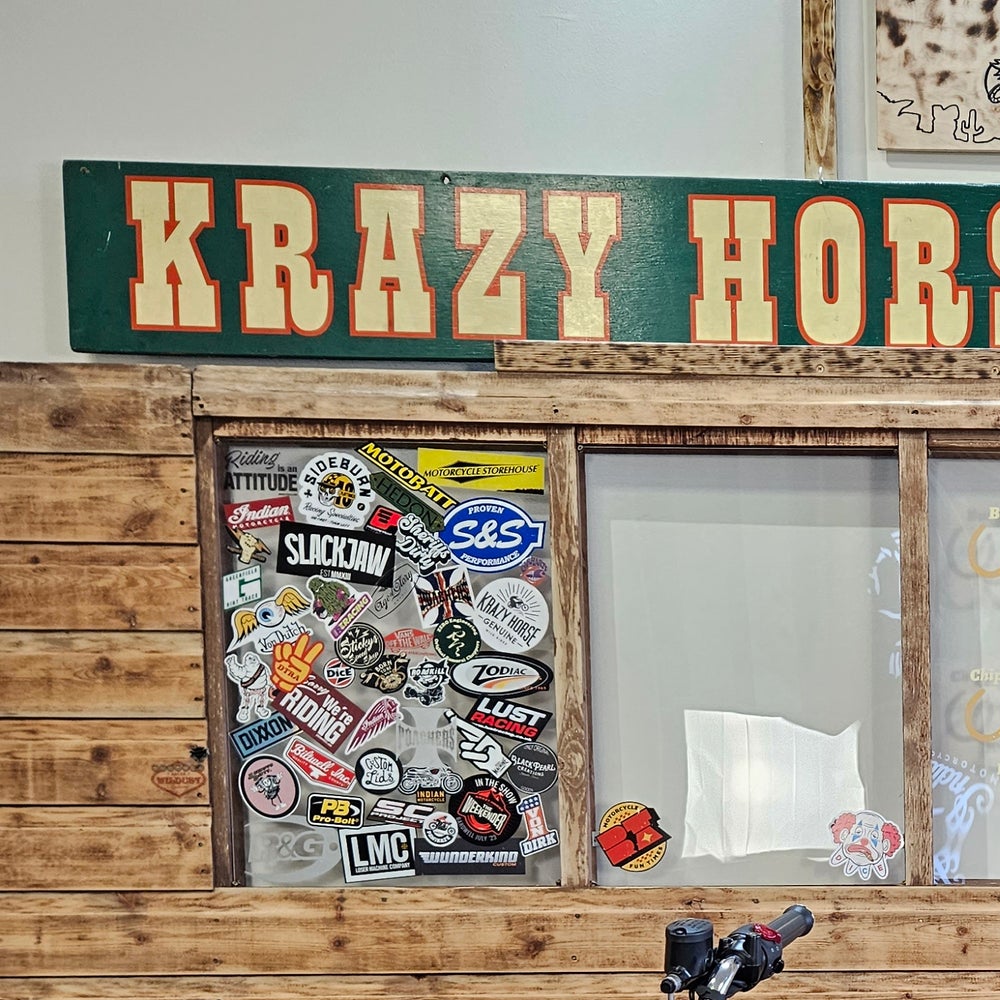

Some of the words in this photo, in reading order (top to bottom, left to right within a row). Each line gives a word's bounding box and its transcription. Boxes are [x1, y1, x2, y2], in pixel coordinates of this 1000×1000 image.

[125, 174, 622, 341] KRAZY
[224, 450, 280, 469] Riding
[224, 472, 297, 491] ATTITUDE
[304, 457, 371, 498] SIDEBURN
[362, 442, 458, 508] MOTOBATT
[423, 467, 481, 477] MOTORCYCLE
[482, 465, 538, 474] STOREHOUSE
[375, 477, 439, 528] HEDON
[468, 504, 505, 515] PROVEN
[228, 504, 291, 524] Indian
[449, 519, 526, 550] S&S
[284, 533, 391, 577] SLACKJAW
[397, 536, 435, 570] Dirty
[460, 550, 521, 566] PERFORMANCE
[477, 591, 511, 622] KRAZY
[507, 615, 541, 647] HORSE
[399, 637, 413, 647] THE
[483, 618, 518, 645] GENUINE
[258, 636, 277, 652] Von
[277, 664, 299, 682] DTRA
[375, 659, 392, 672] BORN
[472, 664, 527, 686] ZODIAC
[280, 687, 346, 745] RIDING
[476, 697, 546, 726] LUST
[238, 715, 294, 750] DIXXON
[470, 711, 538, 737] RACING
[290, 743, 331, 772] Biltwell
[365, 756, 394, 772] CUSTOM
[517, 765, 544, 777] CREATIONS
[416, 790, 445, 798] INDIAN
[475, 778, 484, 788] IN
[484, 777, 499, 789] THE
[499, 783, 518, 804] SHOW
[320, 798, 351, 817] PB
[370, 811, 425, 824] PROJECT
[373, 799, 434, 819] SC
[462, 794, 508, 832] WEEKENDER
[603, 804, 639, 828] MOTORCYCLE
[312, 814, 356, 825] Pro-Bolt
[351, 832, 409, 867] LMC
[522, 832, 557, 854] DIRK
[389, 862, 411, 871] COMPANY
[419, 850, 519, 864] WUNDERKIND
[647, 847, 663, 865] TIMES
